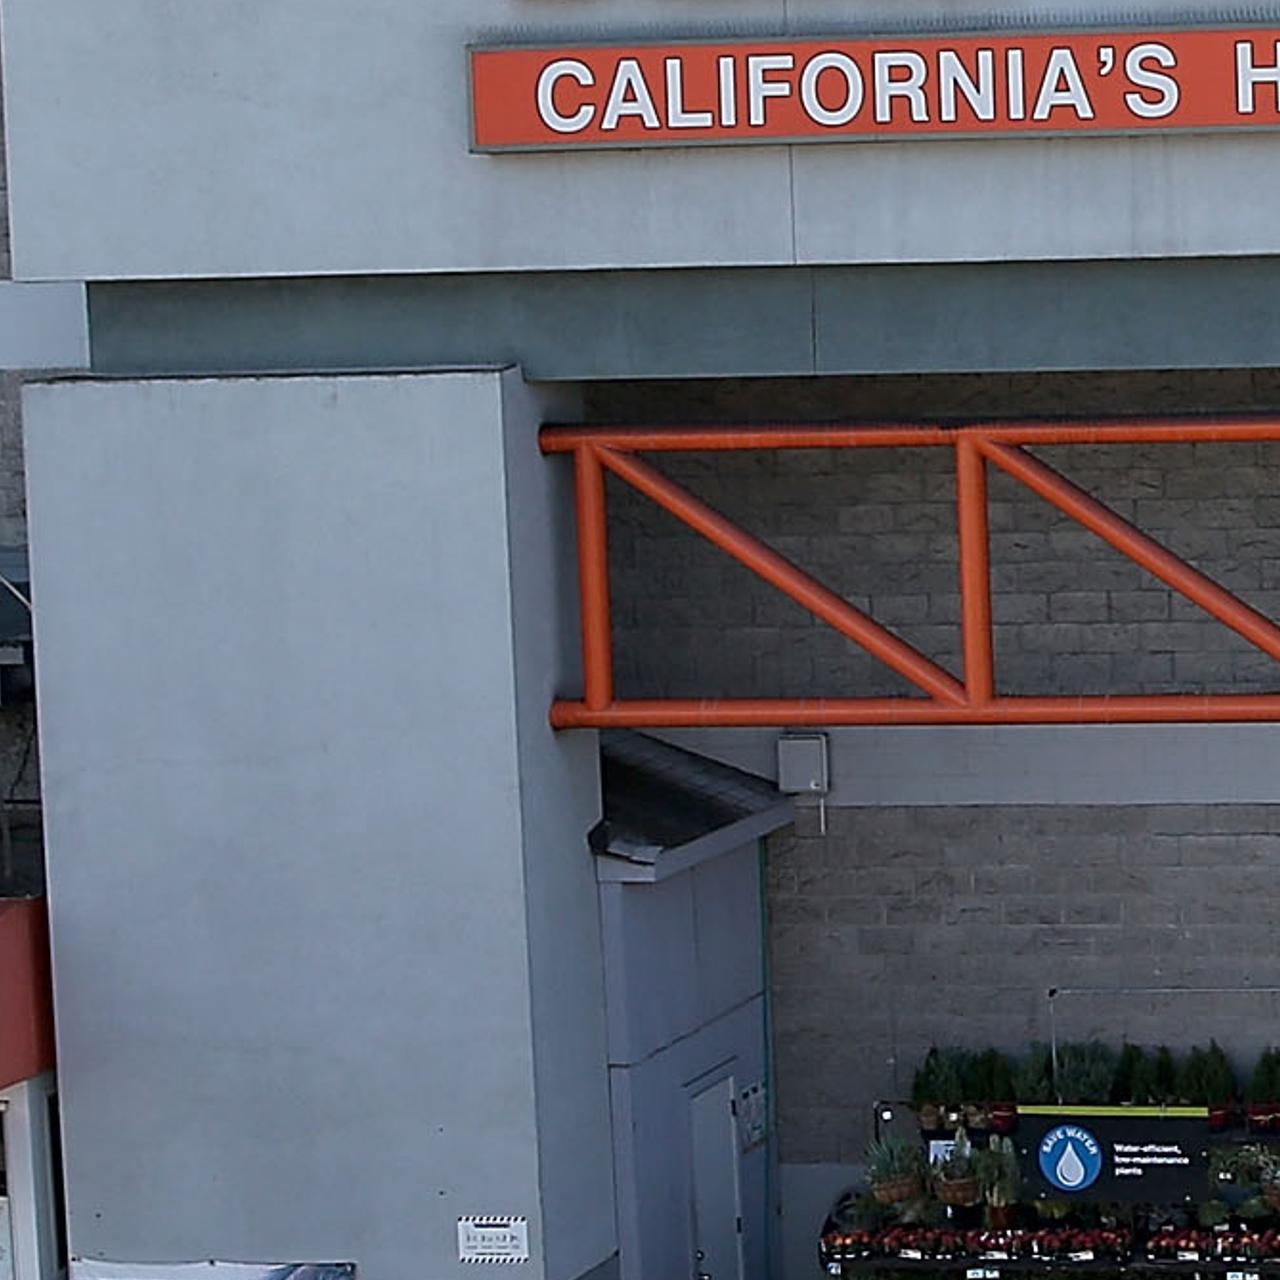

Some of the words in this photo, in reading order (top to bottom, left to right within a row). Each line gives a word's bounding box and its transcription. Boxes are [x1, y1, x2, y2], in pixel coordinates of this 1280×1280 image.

[536, 42, 1181, 134] CALIFORNIA'S
[1042, 1129, 1064, 1154] SAVE
[1065, 1127, 1099, 1155] WATER
